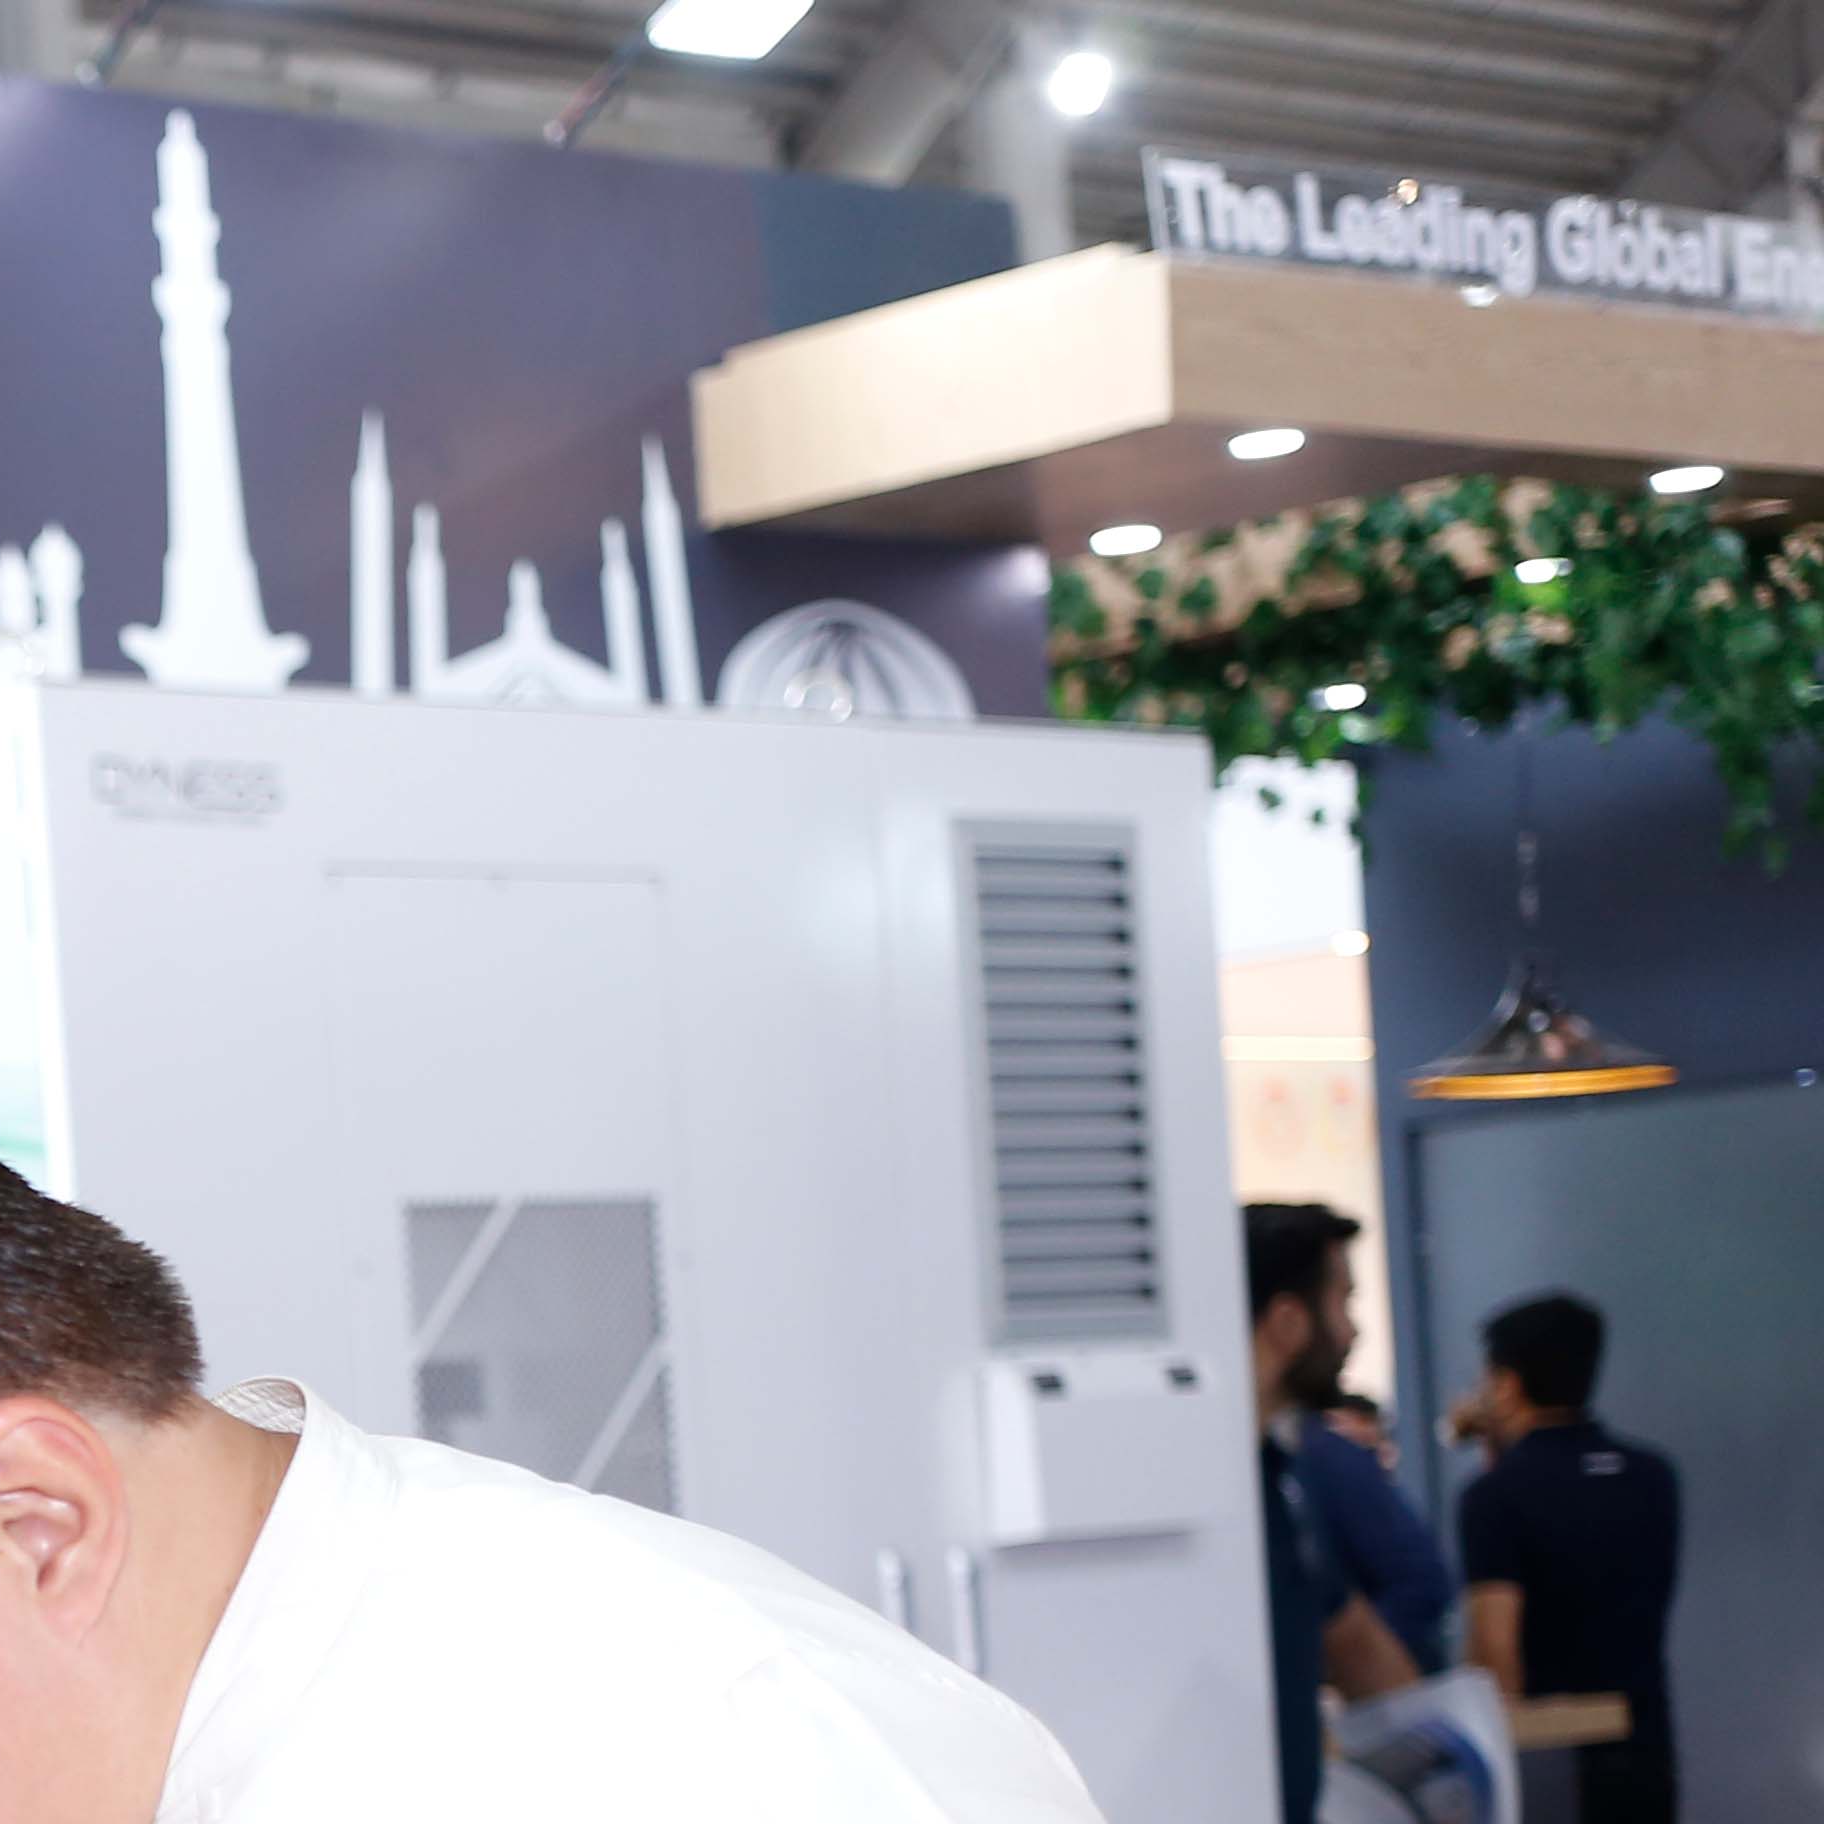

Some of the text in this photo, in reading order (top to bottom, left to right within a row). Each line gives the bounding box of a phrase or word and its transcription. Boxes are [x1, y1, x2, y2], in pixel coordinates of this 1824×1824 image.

[1161, 157, 1291, 254] The
[1294, 170, 1539, 297] Leading
[1545, 192, 1724, 297] Global
